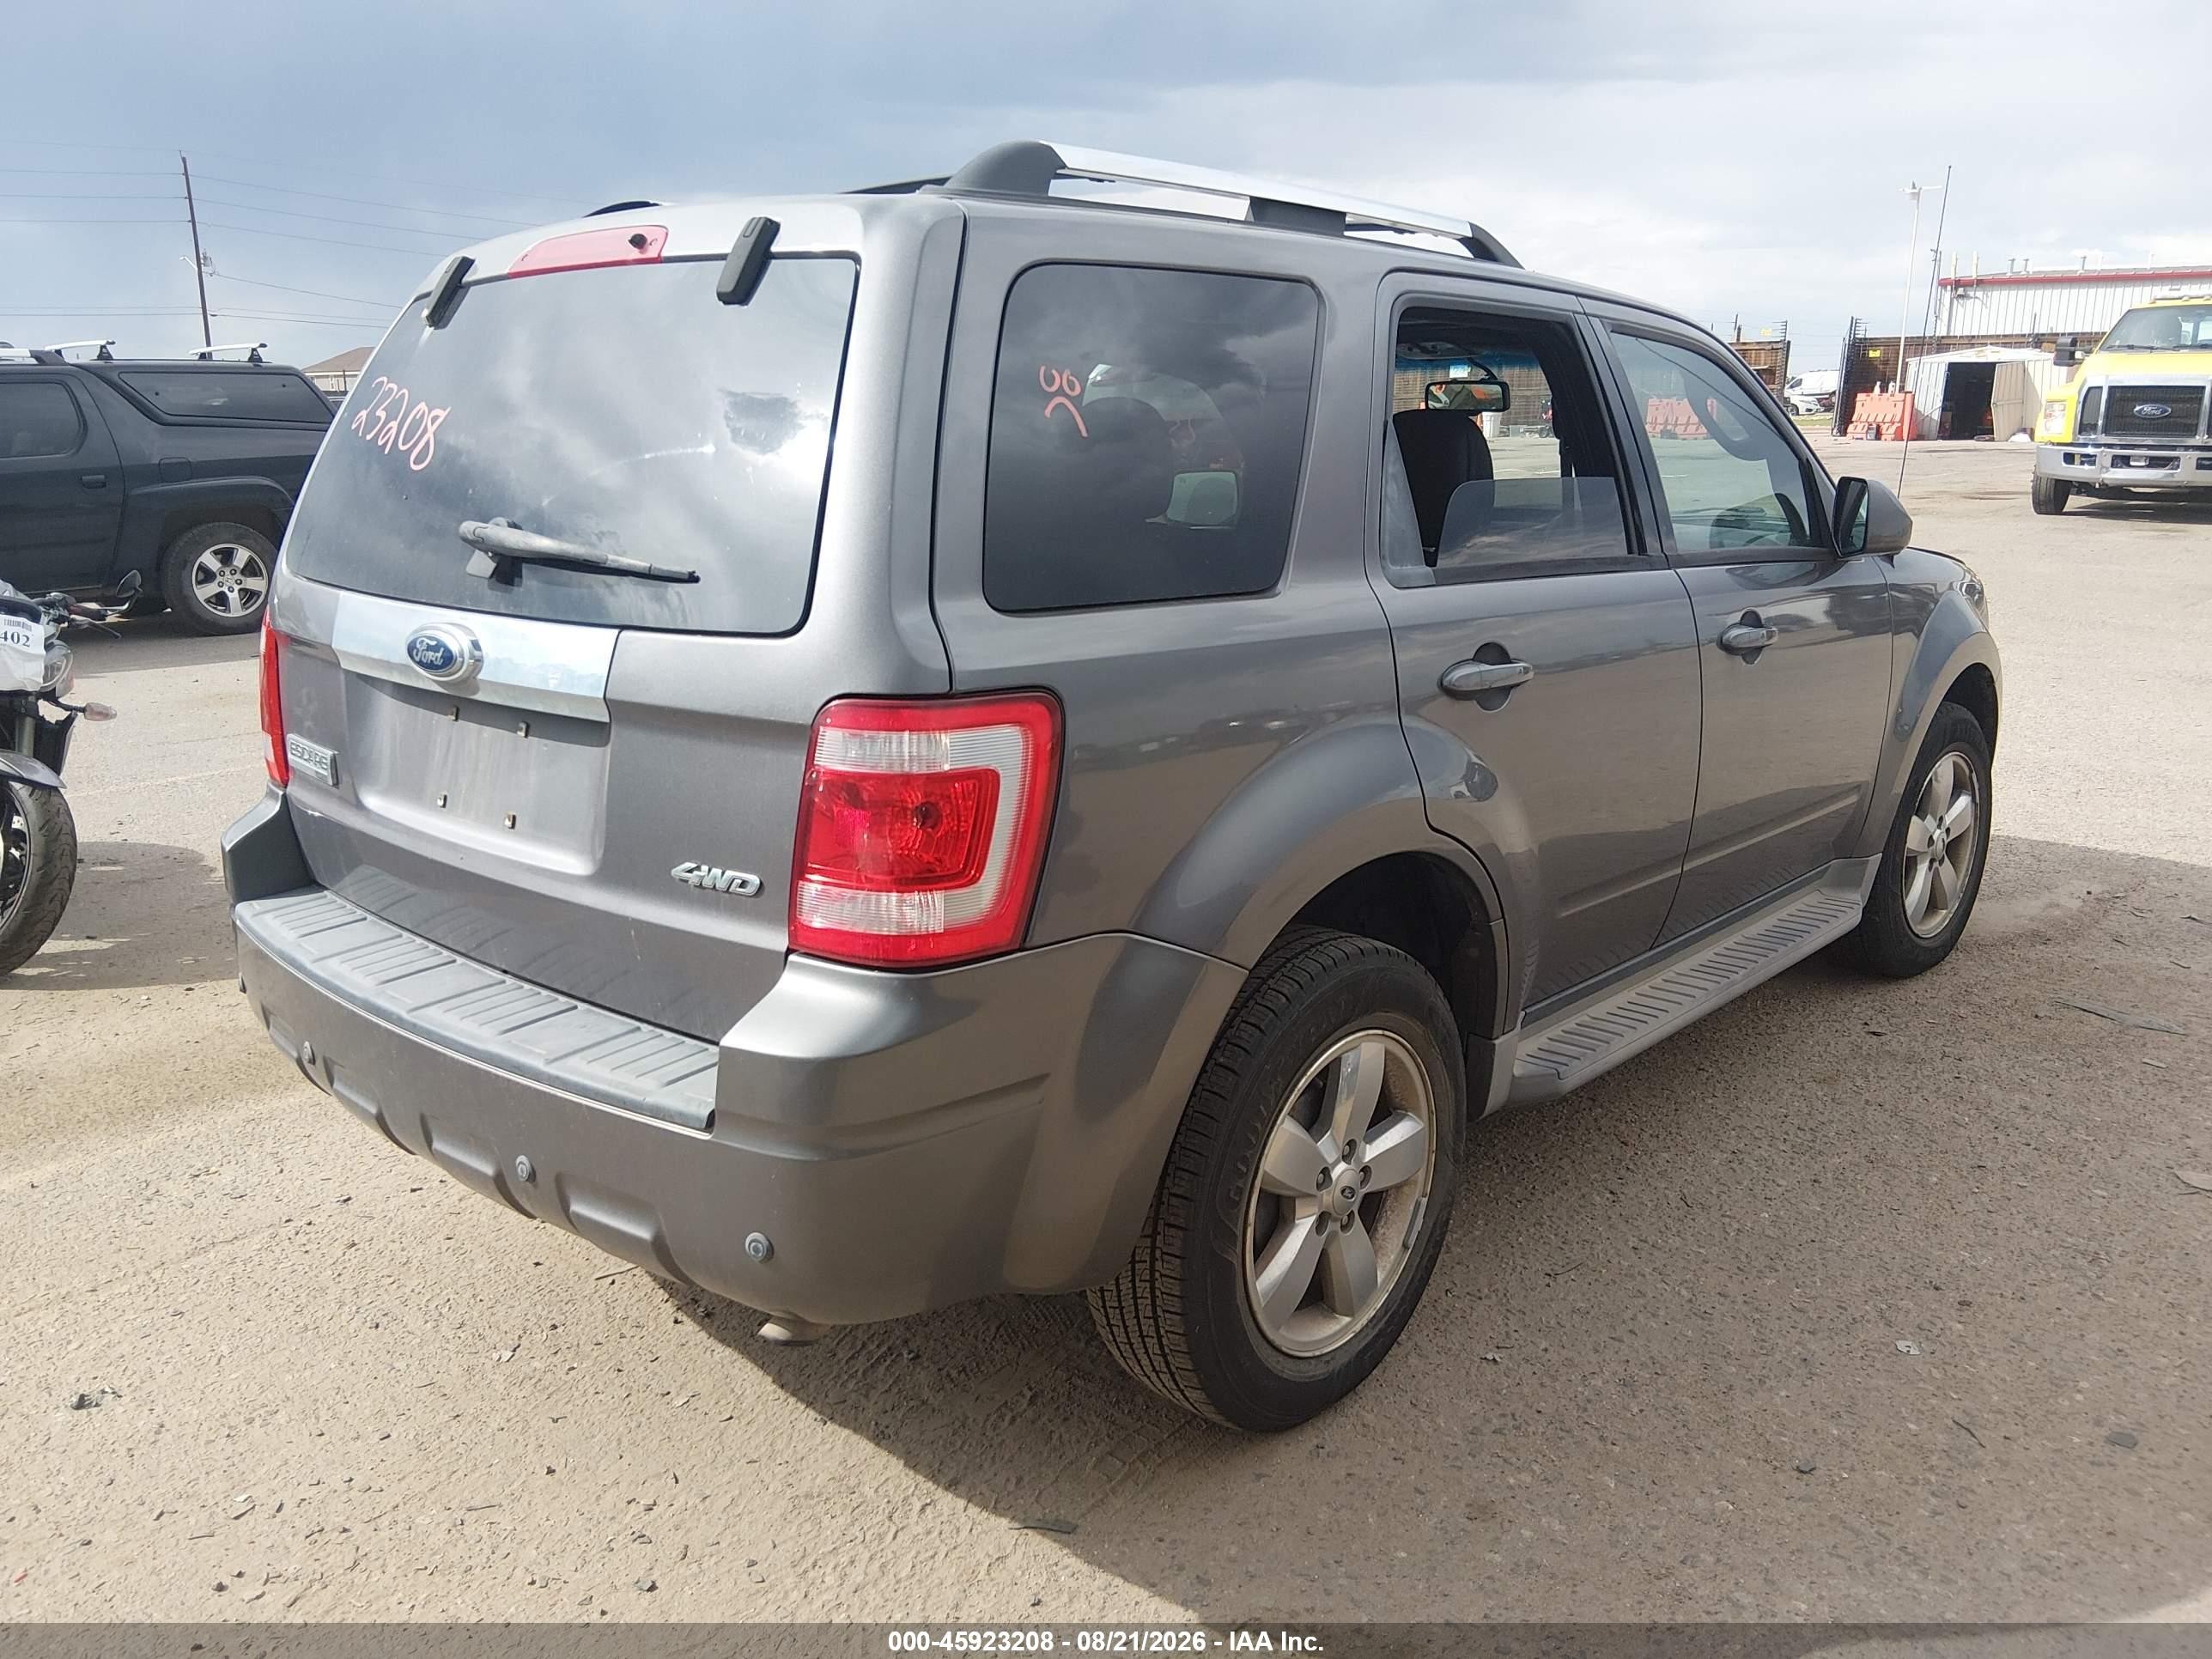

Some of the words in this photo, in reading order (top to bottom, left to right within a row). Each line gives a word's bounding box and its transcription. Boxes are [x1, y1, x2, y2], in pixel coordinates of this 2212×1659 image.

[351, 376, 452, 471] 23208
[413, 637, 446, 665] Ford
[671, 861, 761, 896] 4WD
